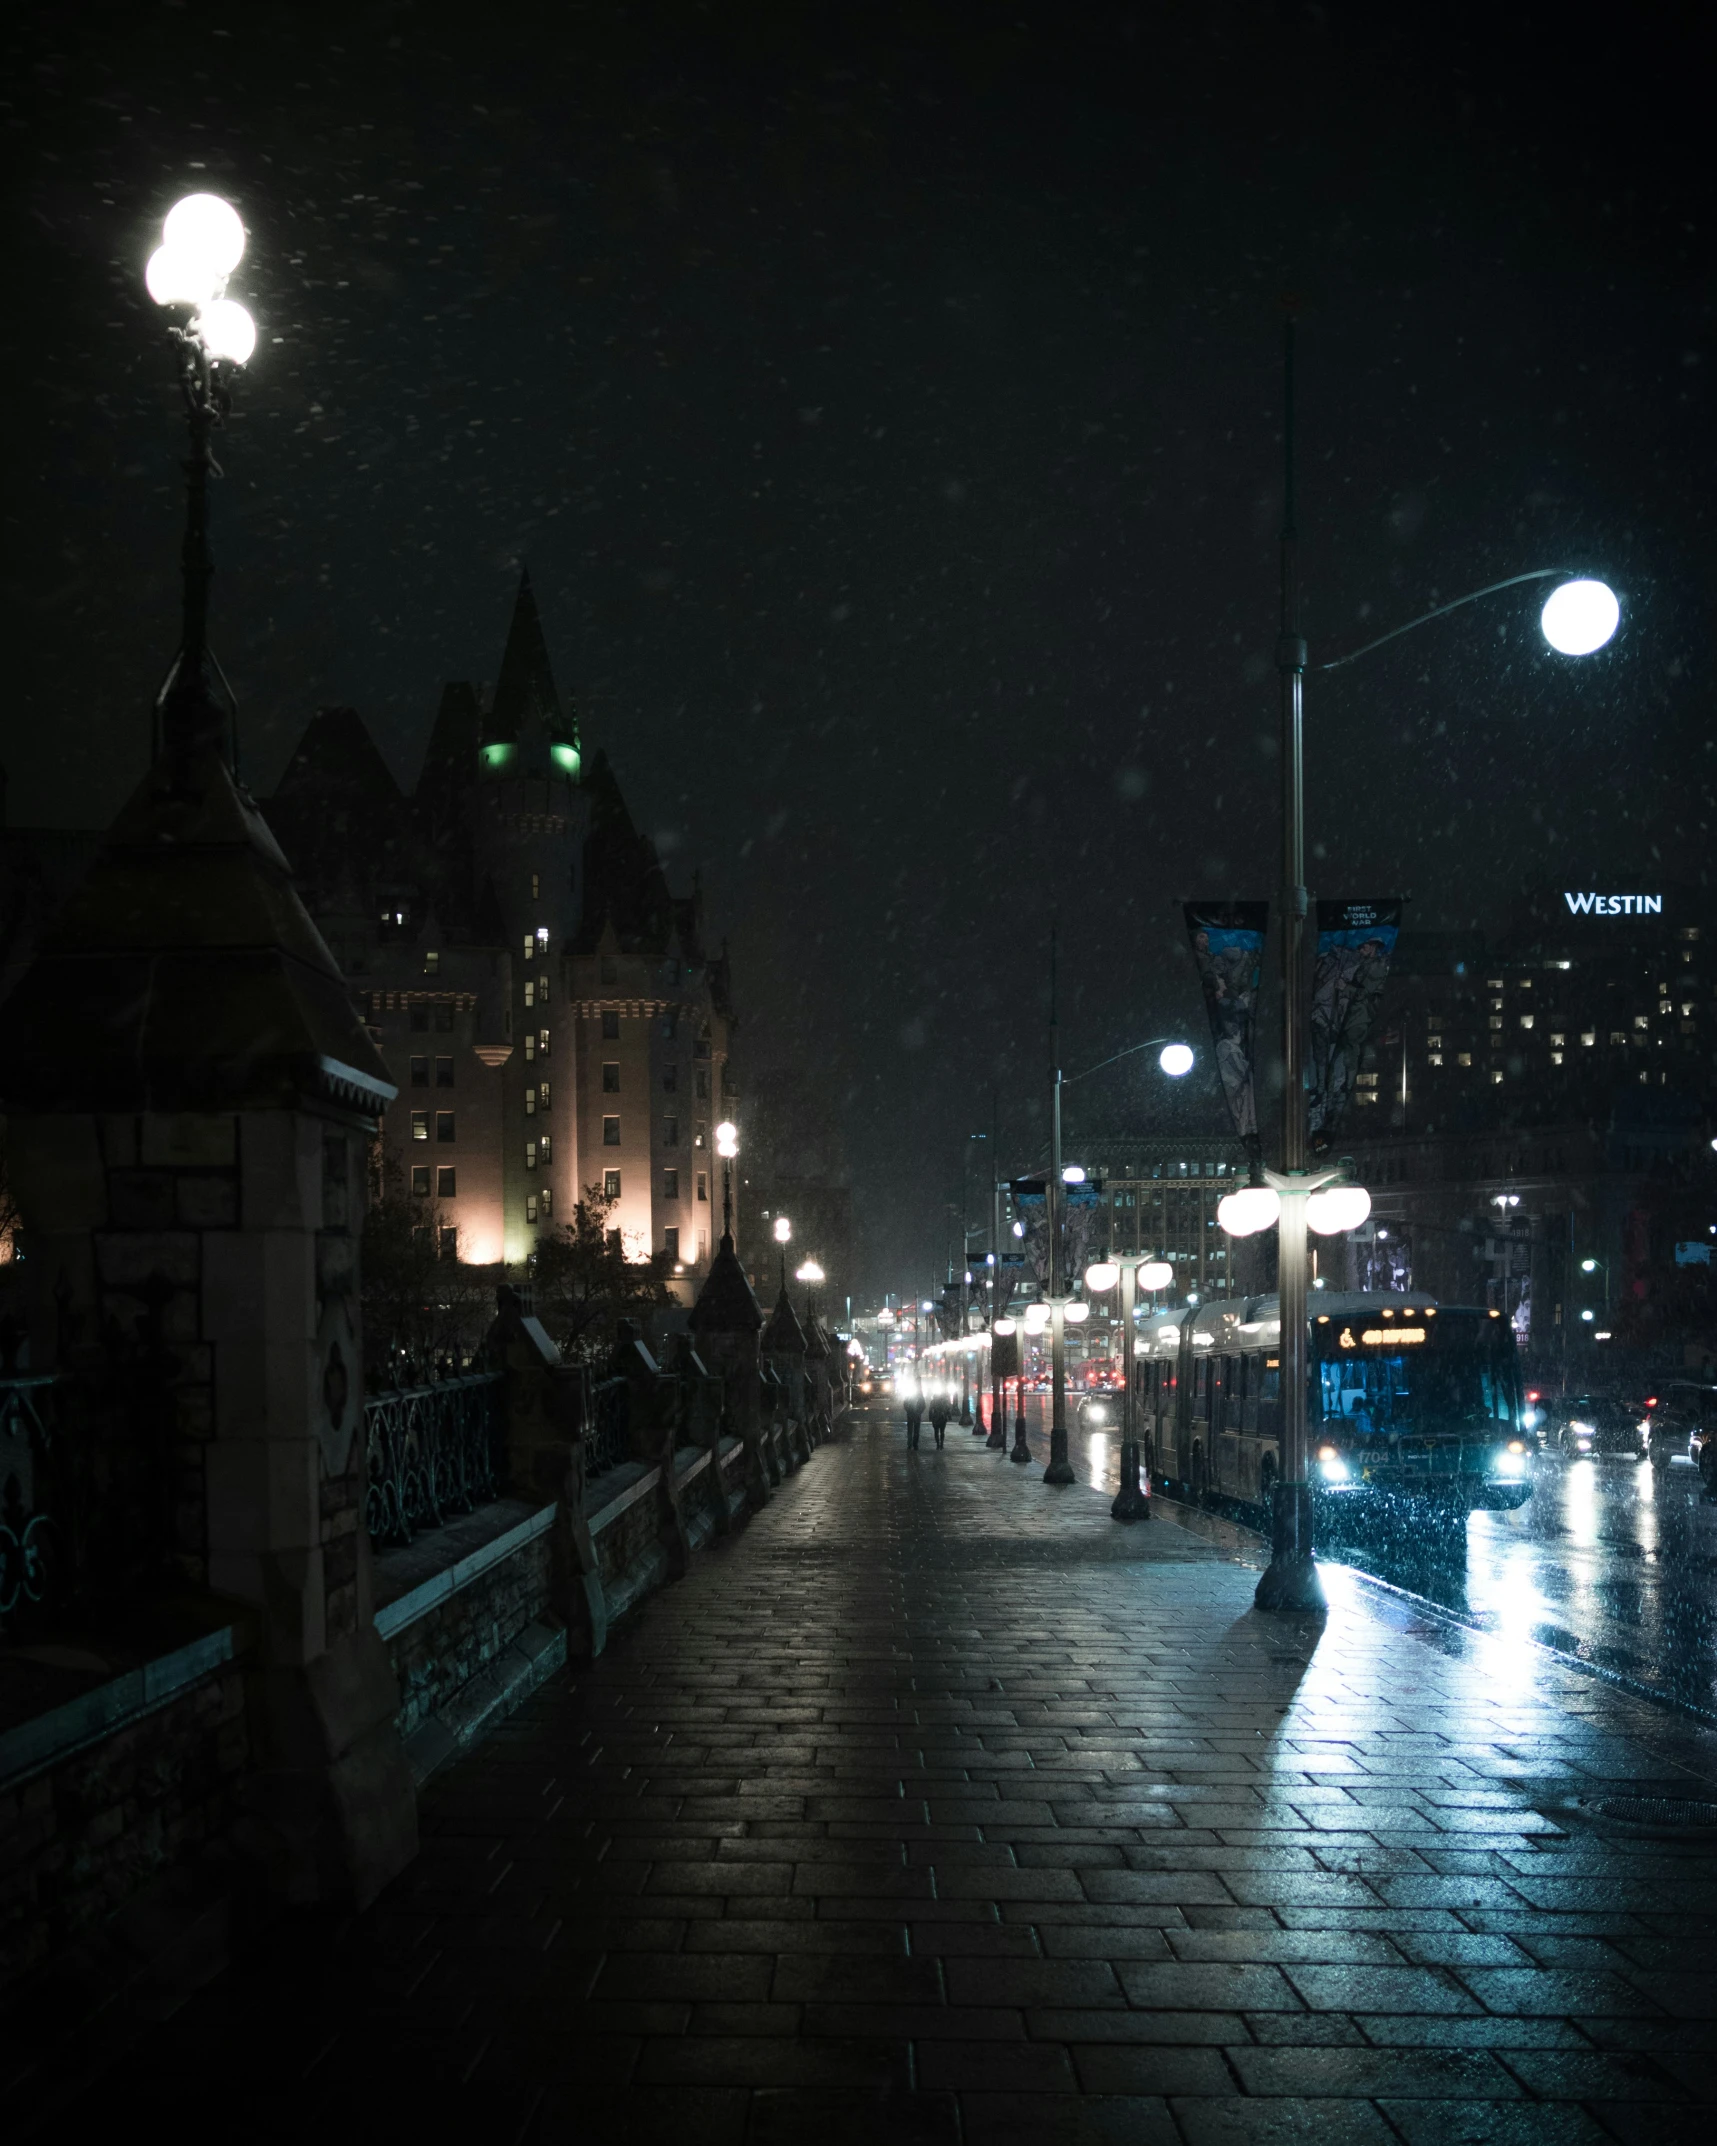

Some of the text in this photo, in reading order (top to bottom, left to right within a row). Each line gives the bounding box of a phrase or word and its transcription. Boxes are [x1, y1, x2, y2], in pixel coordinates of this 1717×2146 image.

[1347, 904, 1372, 913] FIRST
[1563, 891, 1663, 915] WESTIN
[1357, 1449, 1390, 1464] 1704
